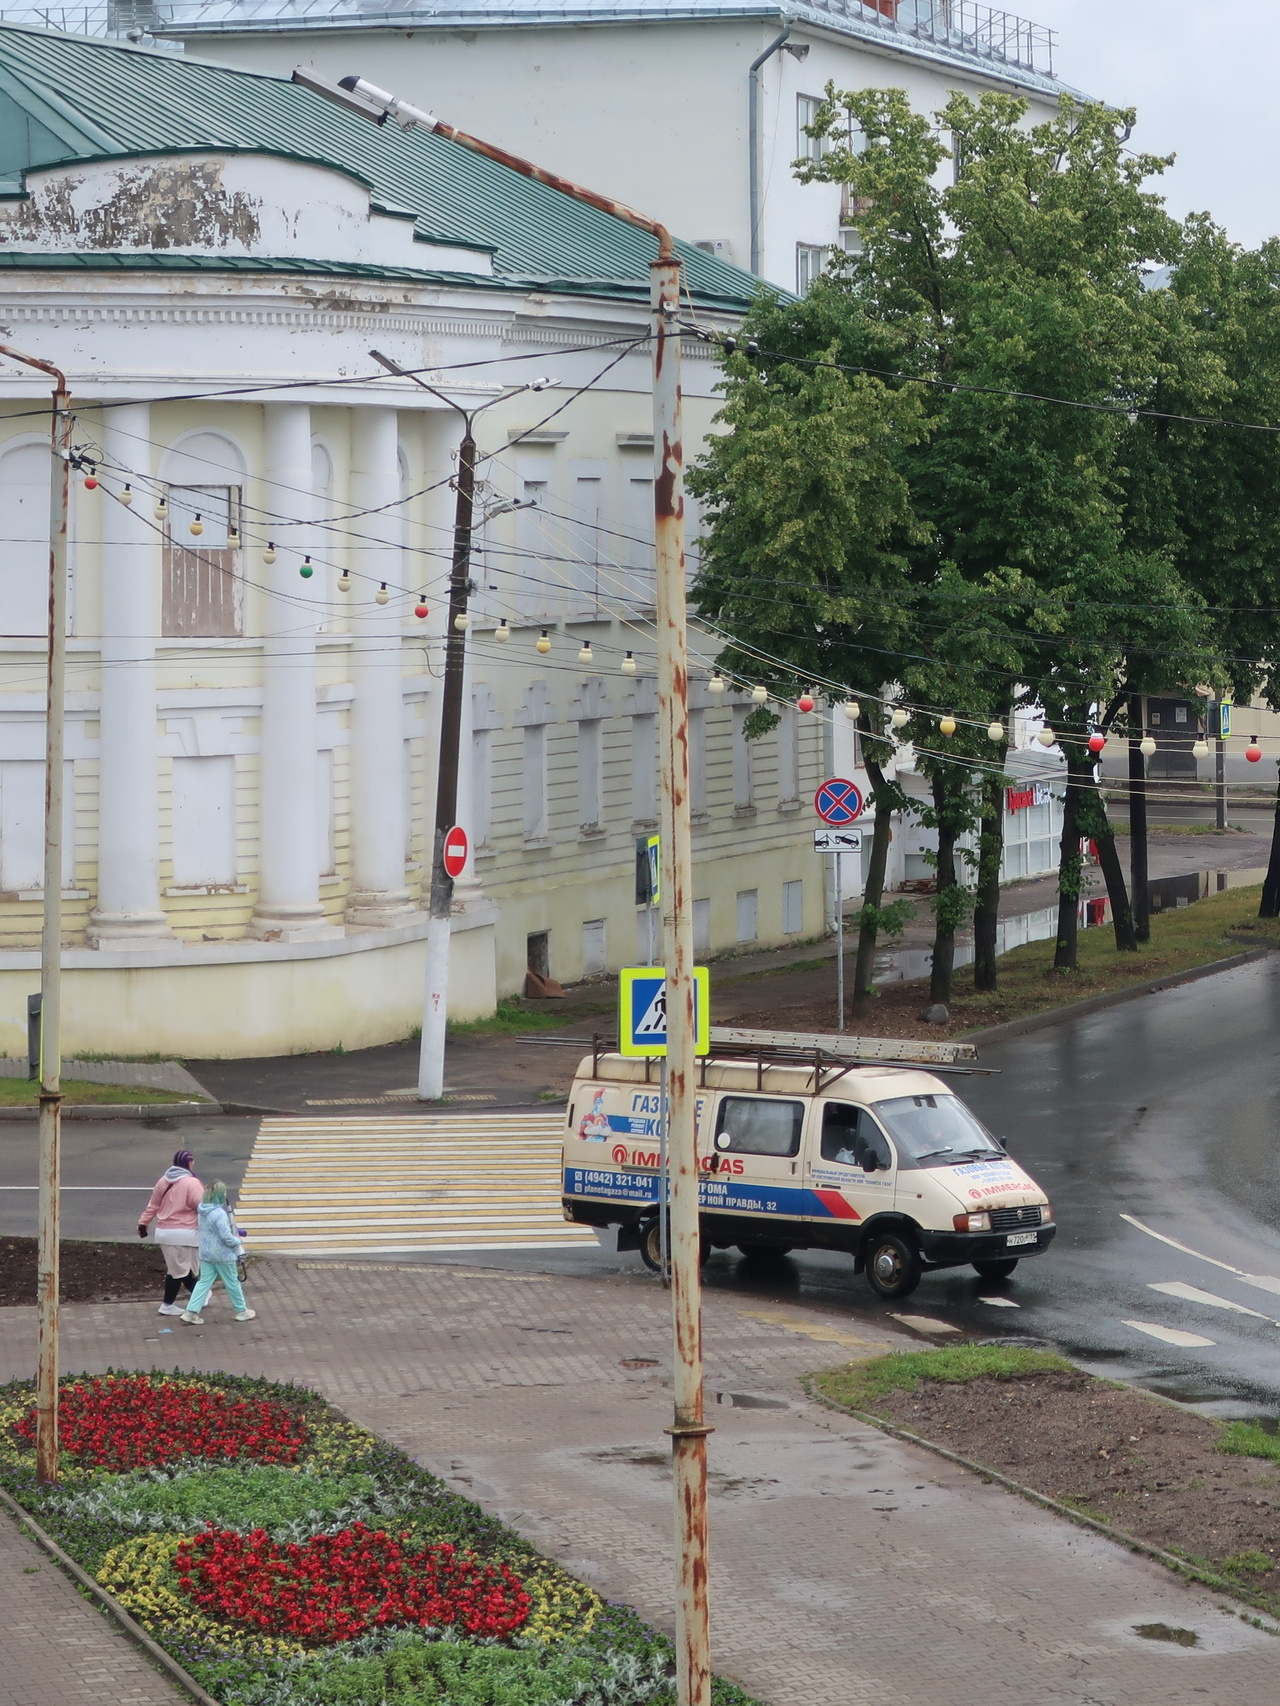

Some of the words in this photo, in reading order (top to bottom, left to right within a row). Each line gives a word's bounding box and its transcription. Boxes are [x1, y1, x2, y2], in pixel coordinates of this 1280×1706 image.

[632, 1094, 703, 1118] ГАЗЕ
[584, 1171, 613, 1186] (4942)
[616, 1174, 652, 1188] 321-041
[584, 1185, 652, 1199] planetagaza@mail.ru
[981, 1183, 1035, 1196] IMMERGAS
[726, 1197, 764, 1211] ПРАВДЫ,
[766, 1201, 777, 1211] 32
